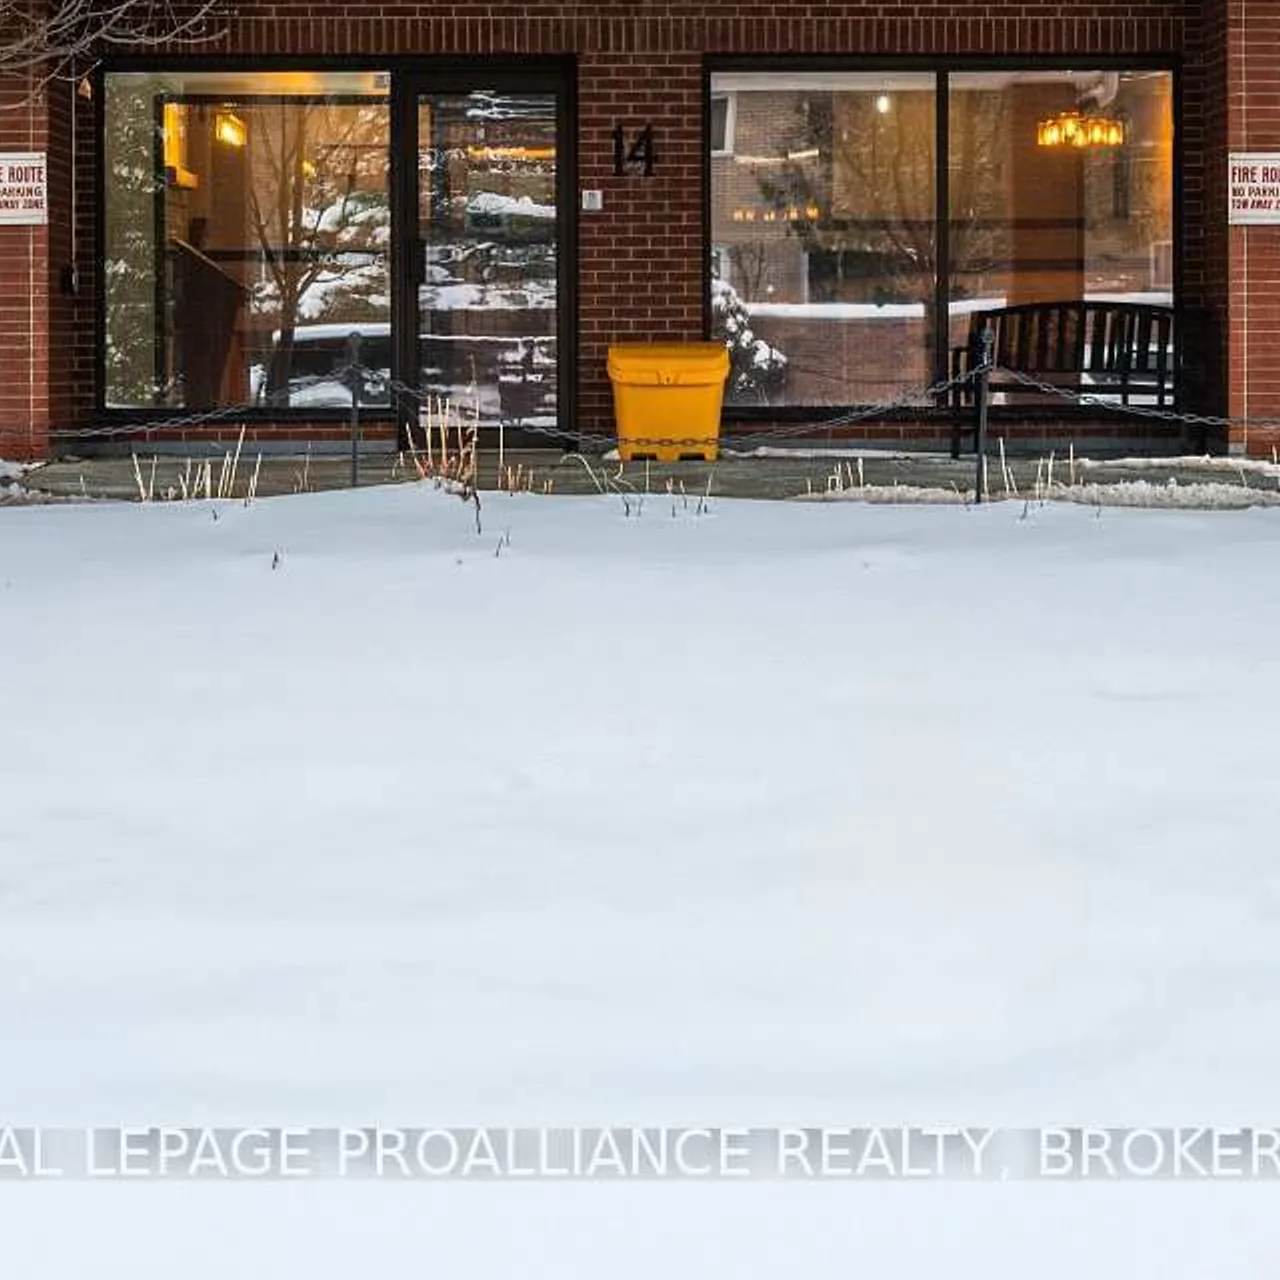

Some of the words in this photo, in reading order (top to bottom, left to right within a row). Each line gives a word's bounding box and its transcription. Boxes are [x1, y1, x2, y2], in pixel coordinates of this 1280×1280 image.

[612, 124, 658, 177] 14
[8, 166, 45, 183] ROUTE
[1231, 166, 1257, 183] FIRE
[1232, 187, 1245, 197] NO
[22, 199, 44, 209] ZONE
[1231, 199, 1249, 209] TOW
[1250, 200, 1274, 209] AWAY
